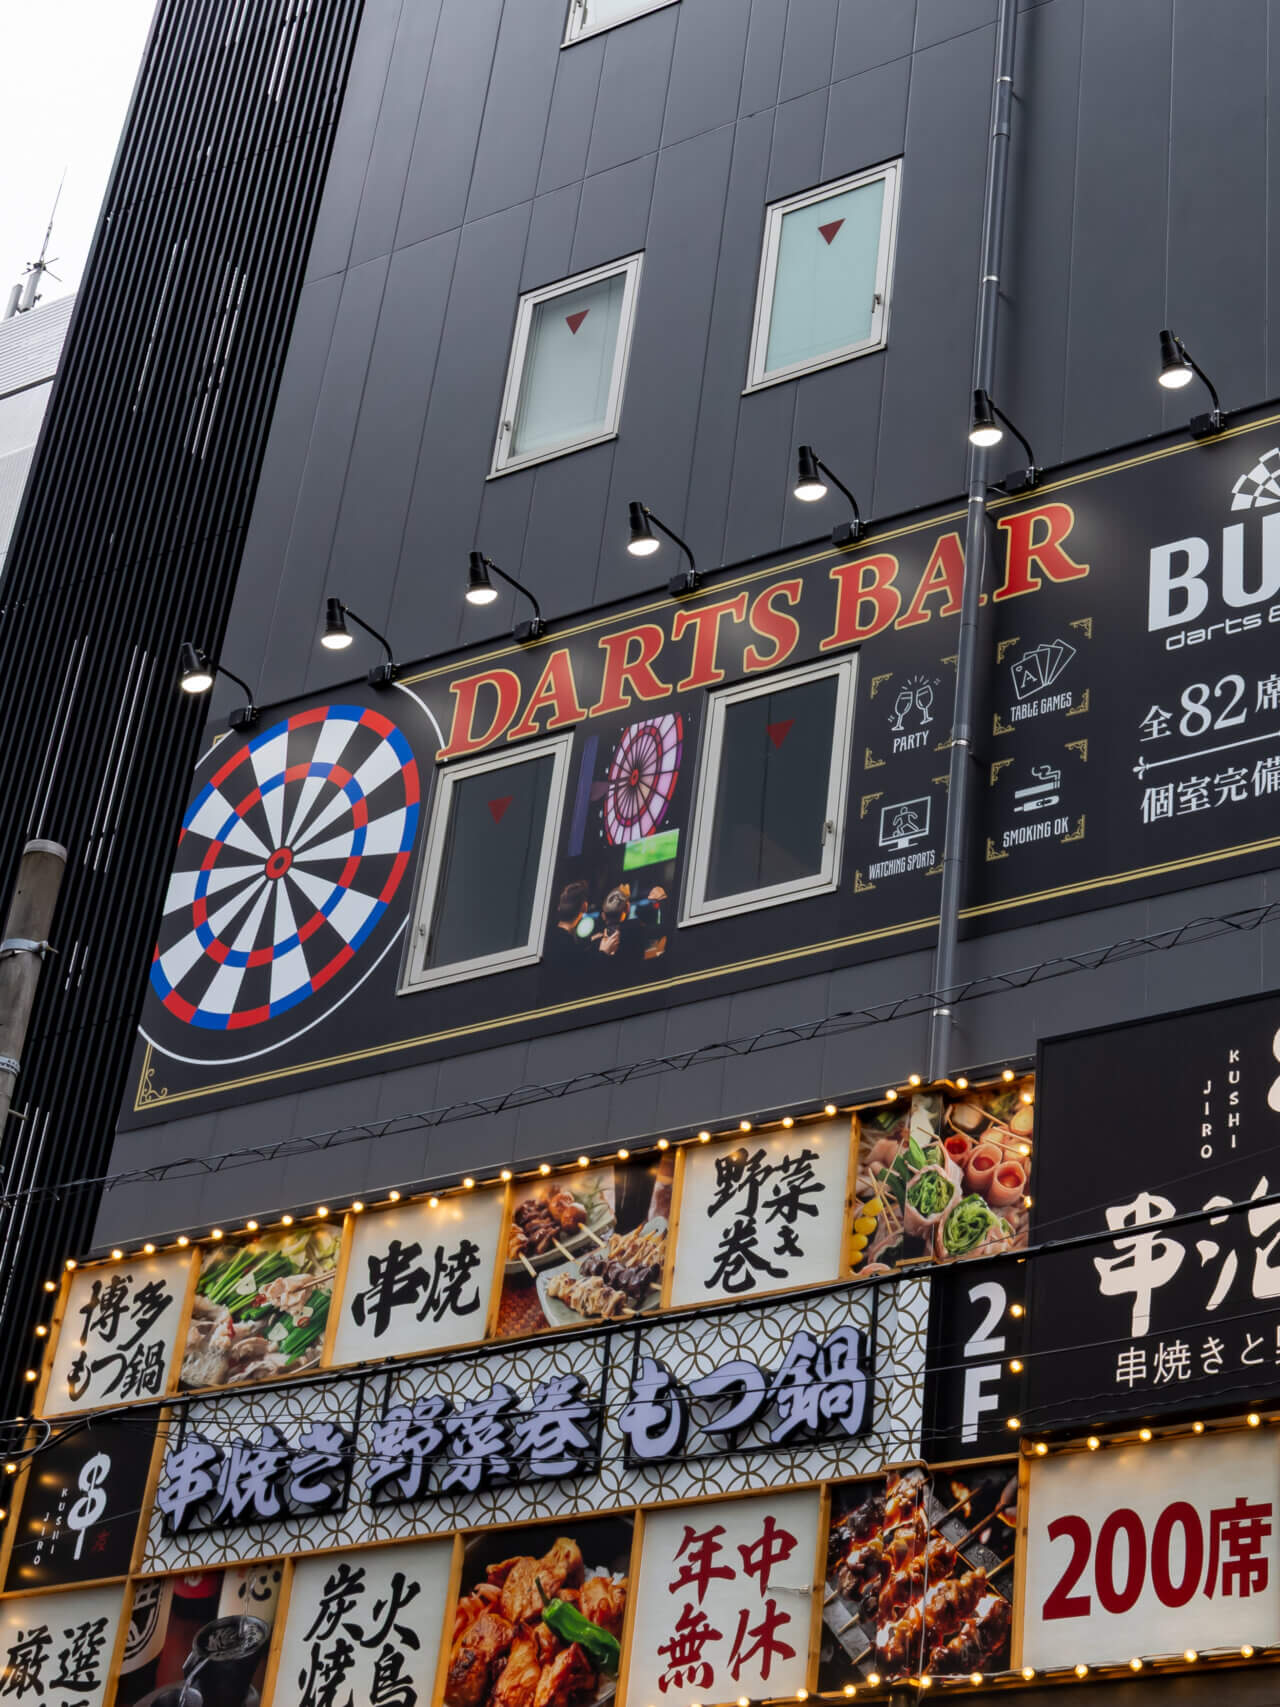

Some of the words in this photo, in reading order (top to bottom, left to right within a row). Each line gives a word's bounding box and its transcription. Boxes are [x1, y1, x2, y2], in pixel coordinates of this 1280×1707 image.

[435, 578, 803, 761] DARTS
[819, 503, 1089, 651] BAR
[1166, 613, 1262, 651] darts
[893, 730, 930, 753] PARTY
[1010, 701, 1038, 722] TABLE
[1040, 692, 1073, 714] GAMES
[869, 857, 906, 881] WATCHING
[907, 849, 935, 871] SPORTS
[1003, 821, 1051, 848] SMOKING
[1054, 816, 1069, 836] OK
[1201, 1080, 1213, 1159] JIRO
[1228, 1049, 1240, 1148] KUSHI
[708, 1147, 827, 1225] 野菜
[351, 1239, 481, 1338] 串焼
[704, 1220, 805, 1294] 巻き
[79, 1275, 174, 1350] 博多
[66, 1340, 166, 1401] もつ鍋
[157, 1420, 346, 1531] 串焼き
[617, 1324, 869, 1460] もつ鍋
[669, 1514, 799, 1604] 年中
[1042, 1495, 1273, 1622] 200席
[302, 1563, 421, 1651] 炭火
[656, 1597, 797, 1694] 無休
[0, 1616, 109, 1699] 厳選
